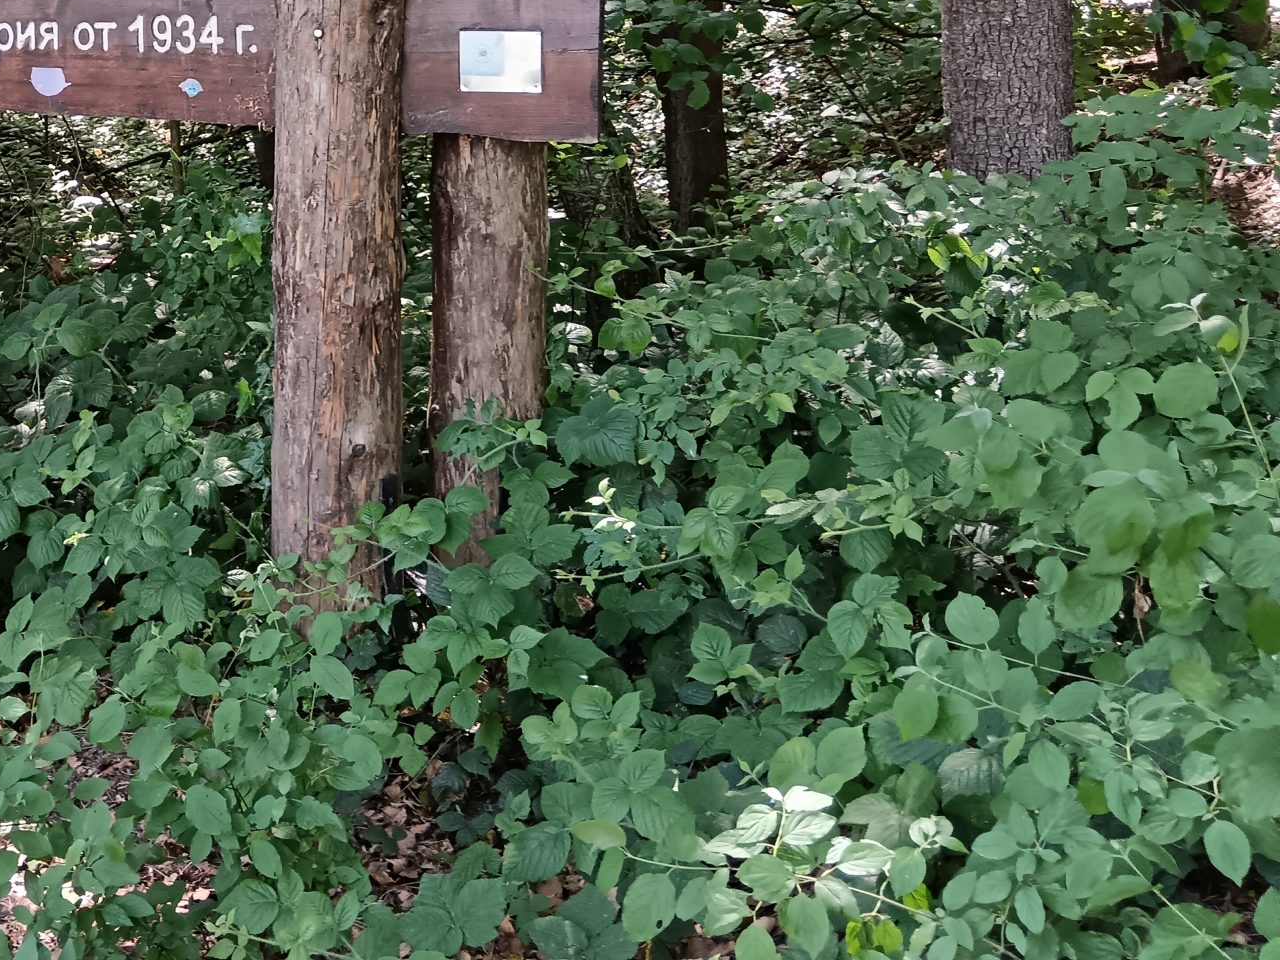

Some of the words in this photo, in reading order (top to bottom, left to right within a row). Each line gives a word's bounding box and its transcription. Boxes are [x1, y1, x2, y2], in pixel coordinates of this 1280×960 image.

[73, 21, 118, 52] от
[127, 14, 224, 54] 1934
[235, 23, 258, 55] г.
